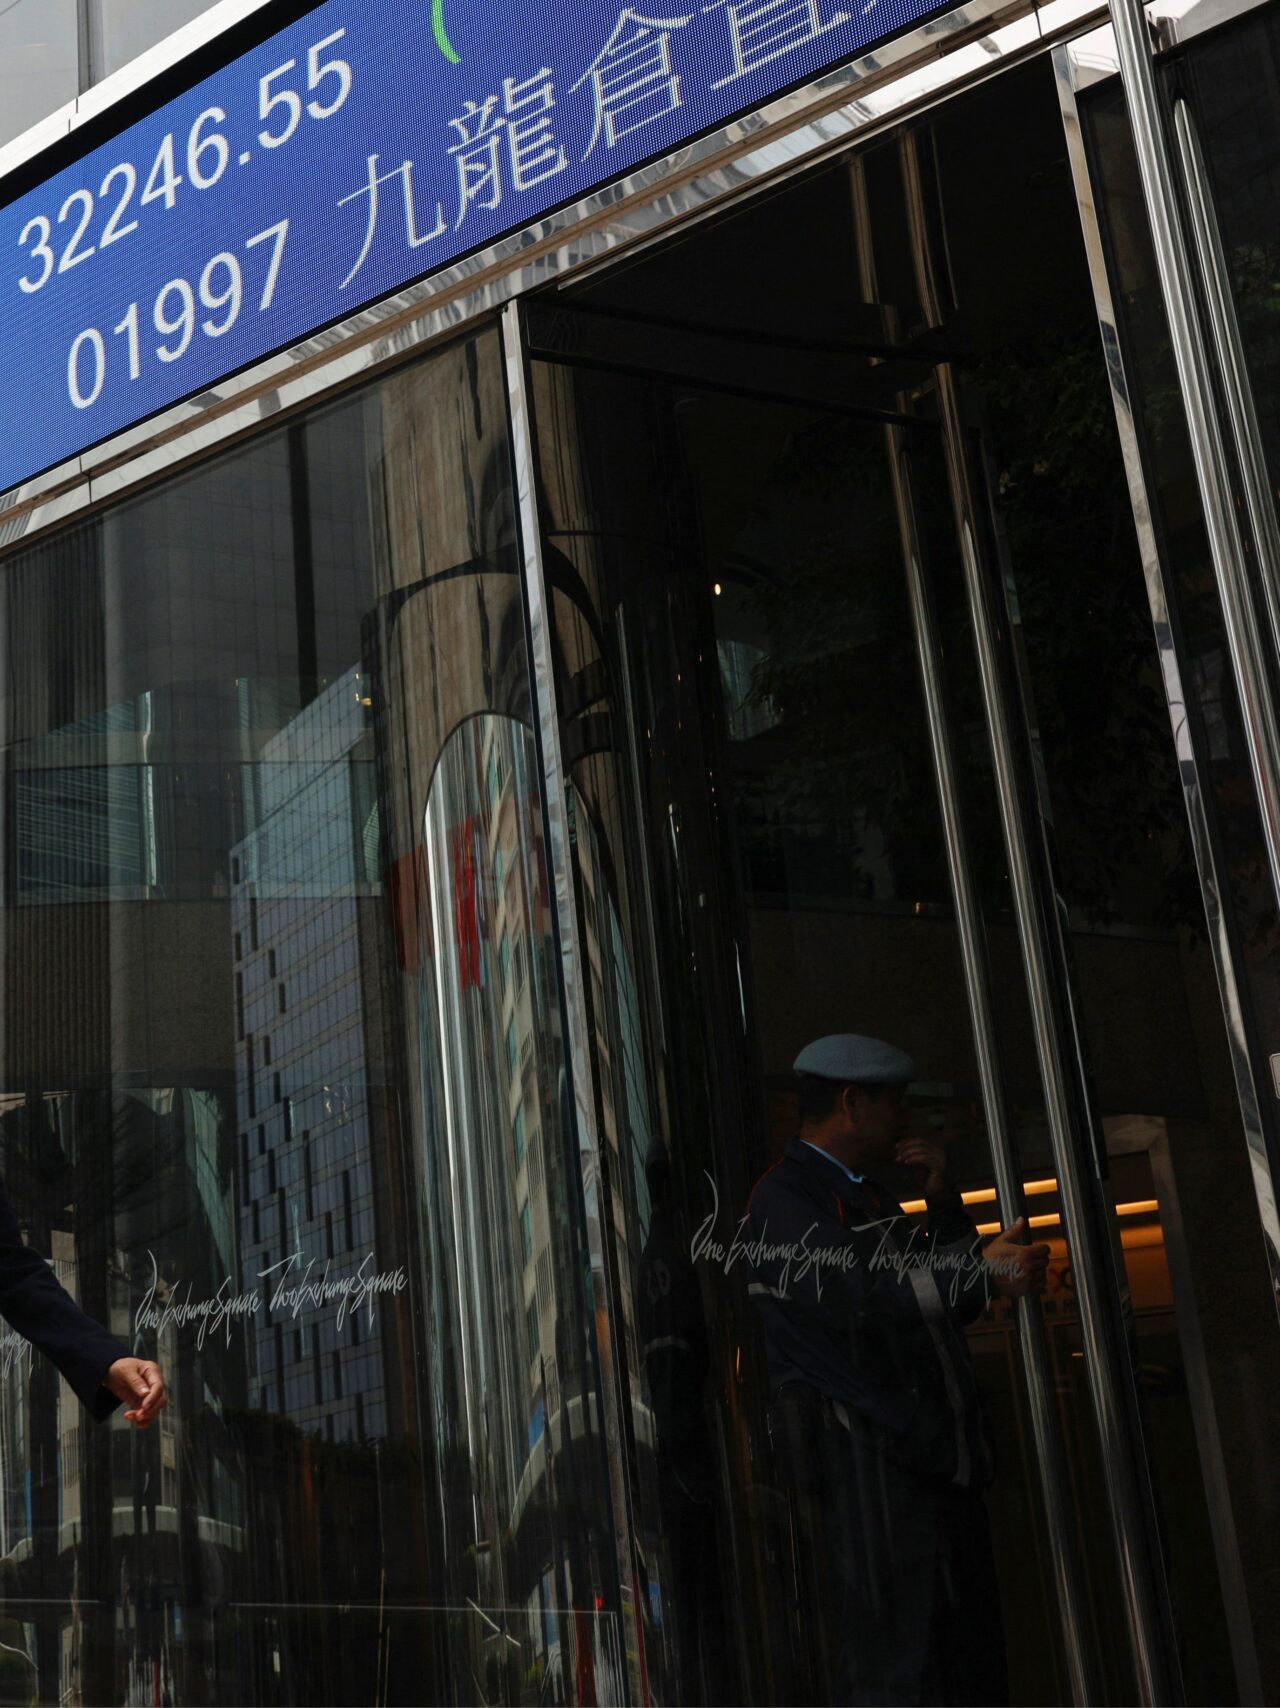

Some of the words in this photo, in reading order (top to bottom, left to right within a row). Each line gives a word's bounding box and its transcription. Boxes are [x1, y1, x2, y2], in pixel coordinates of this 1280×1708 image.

[17, 27, 353, 293] 32246.55
[67, 218, 290, 410] 01997
[135, 1249, 160, 1334] One
[157, 1279, 219, 1351] Exchange
[209, 1275, 263, 1350] Square
[291, 1257, 356, 1333] Exchange
[349, 1252, 409, 1335] Square
[691, 1168, 726, 1265] One
[723, 1212, 806, 1299] Exchange
[792, 1222, 859, 1303] Square
